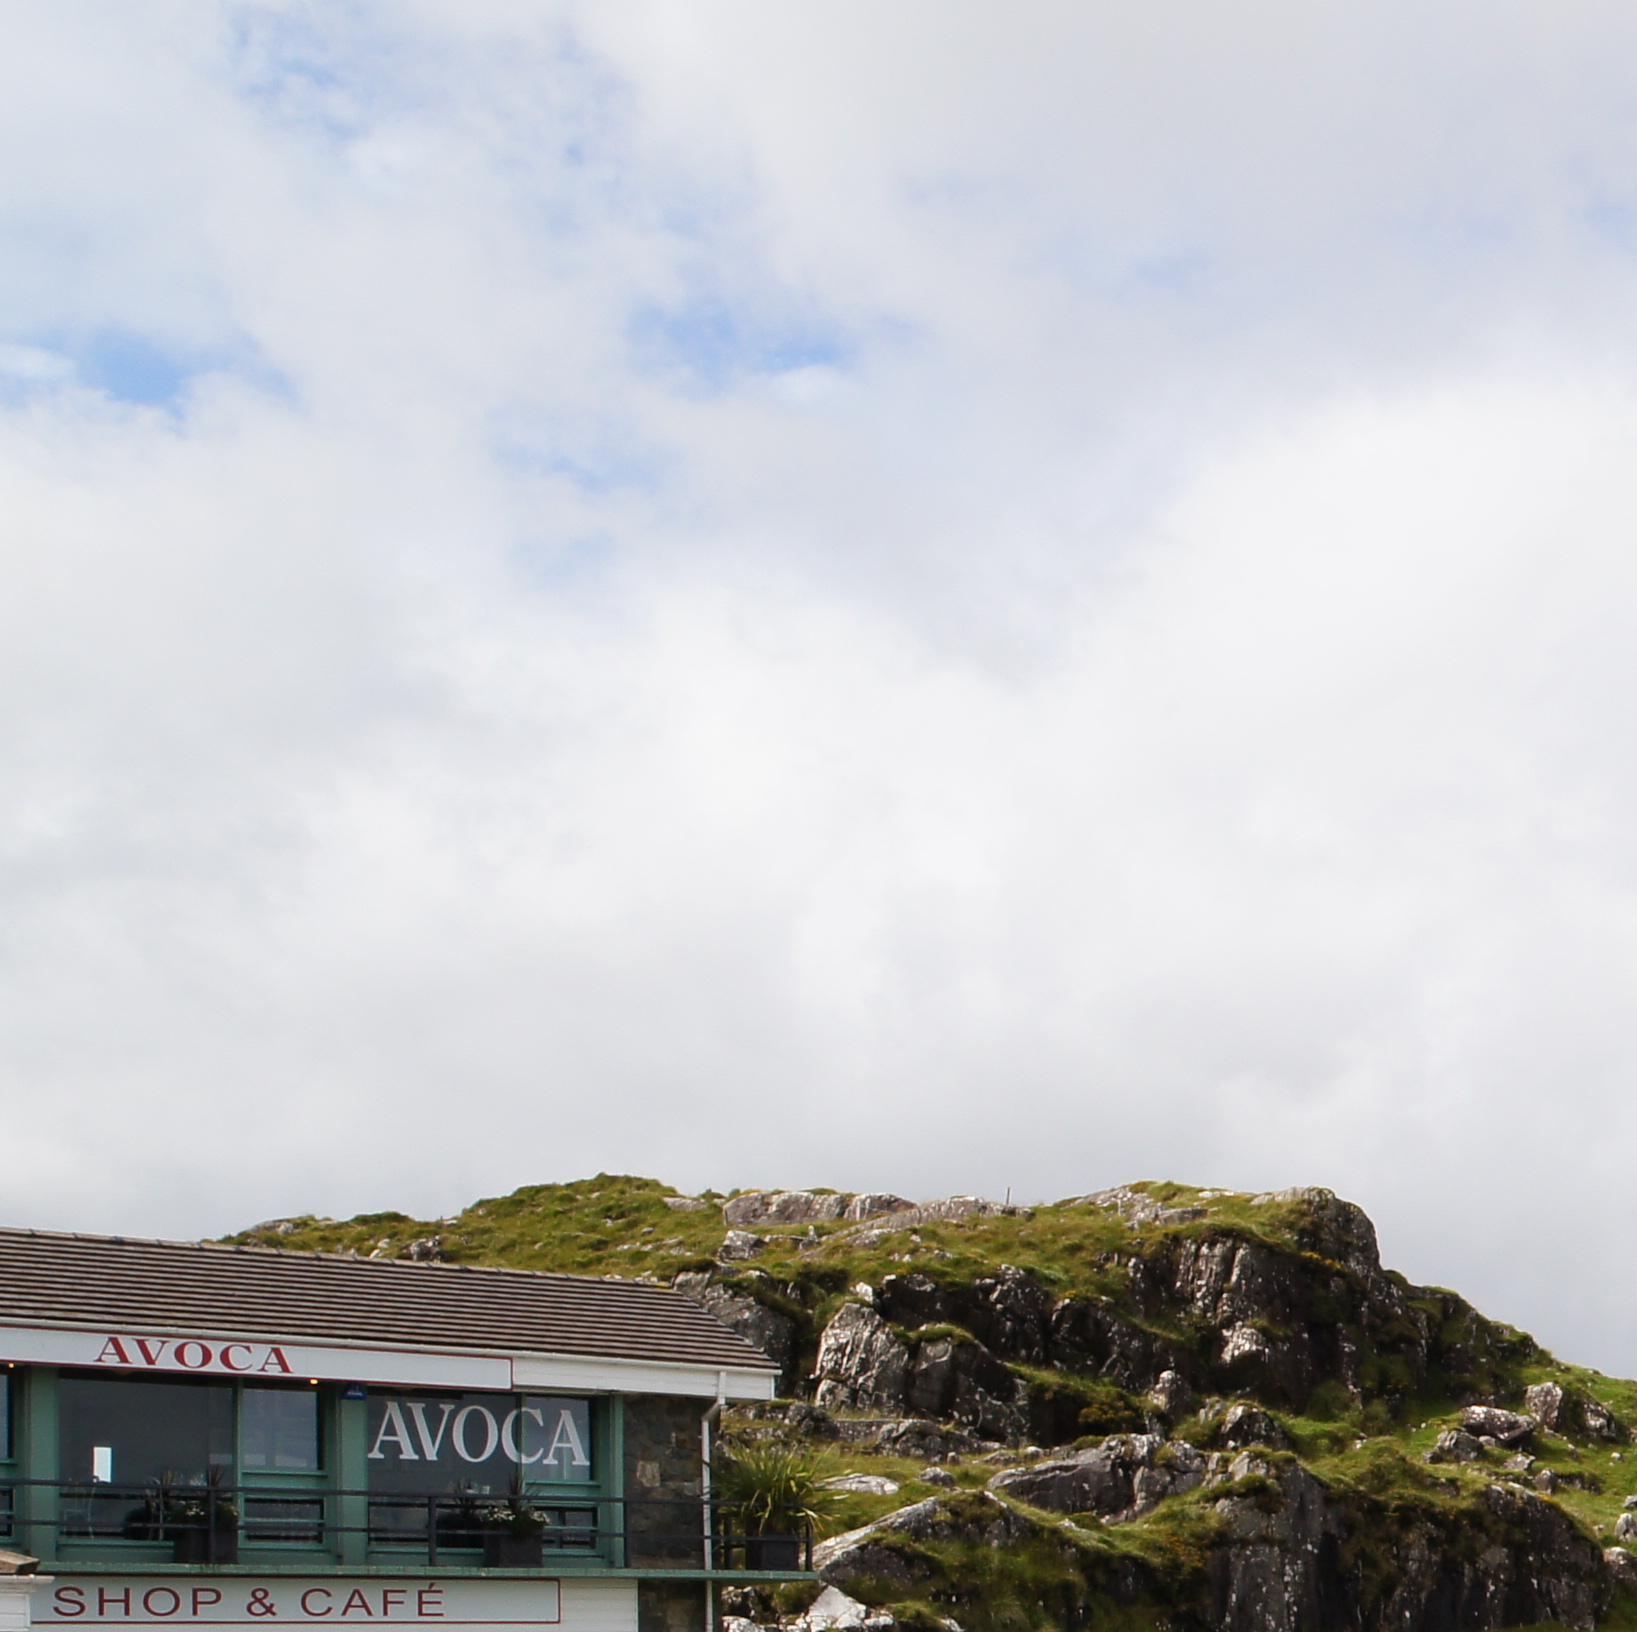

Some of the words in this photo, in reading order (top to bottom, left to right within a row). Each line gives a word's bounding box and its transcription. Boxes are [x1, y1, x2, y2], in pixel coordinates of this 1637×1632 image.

[94, 1336, 293, 1374] AVOCA
[367, 1400, 590, 1466] AVOCA
[53, 1586, 222, 1617] SHOP
[246, 1587, 277, 1617] &
[300, 1582, 445, 1618] CAFÉ
